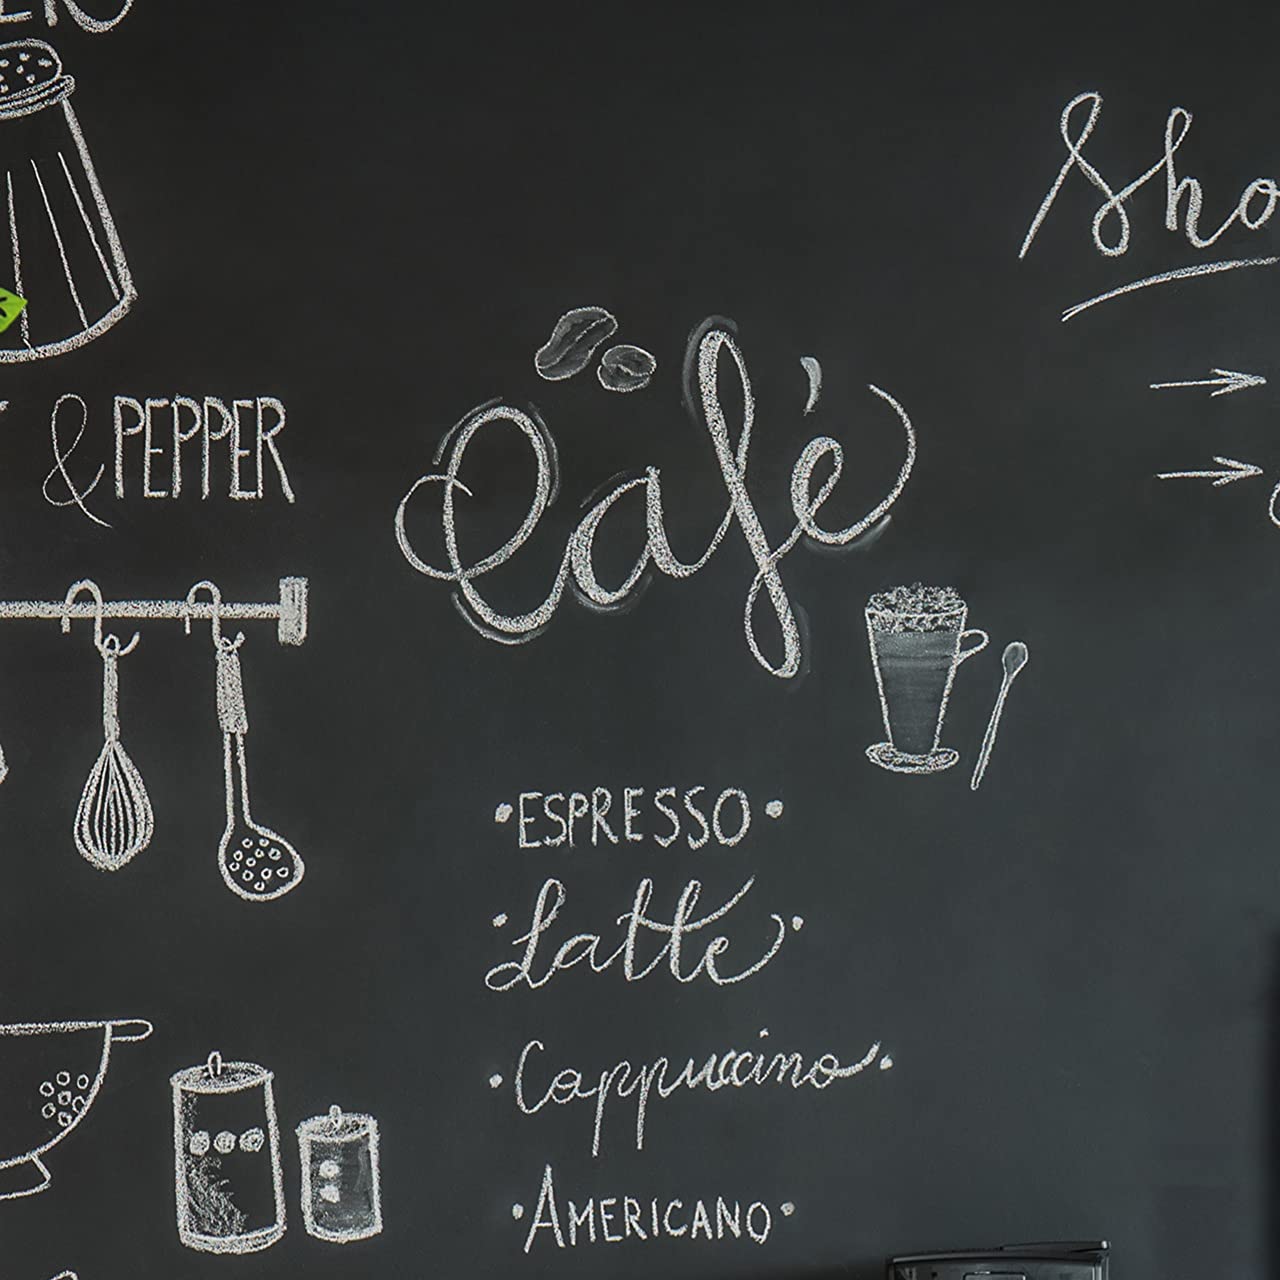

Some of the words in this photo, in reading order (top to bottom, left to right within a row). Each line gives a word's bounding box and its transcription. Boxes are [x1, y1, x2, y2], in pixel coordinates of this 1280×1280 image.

[42, 392, 112, 528] &
[113, 393, 297, 503] PEPPER
[395, 329, 917, 679] Café
[518, 786, 753, 850] ESPRESSO
[484, 874, 786, 992] Latte
[515, 1027, 883, 1157] Cappuccino
[523, 1164, 773, 1254] AMERICANO
